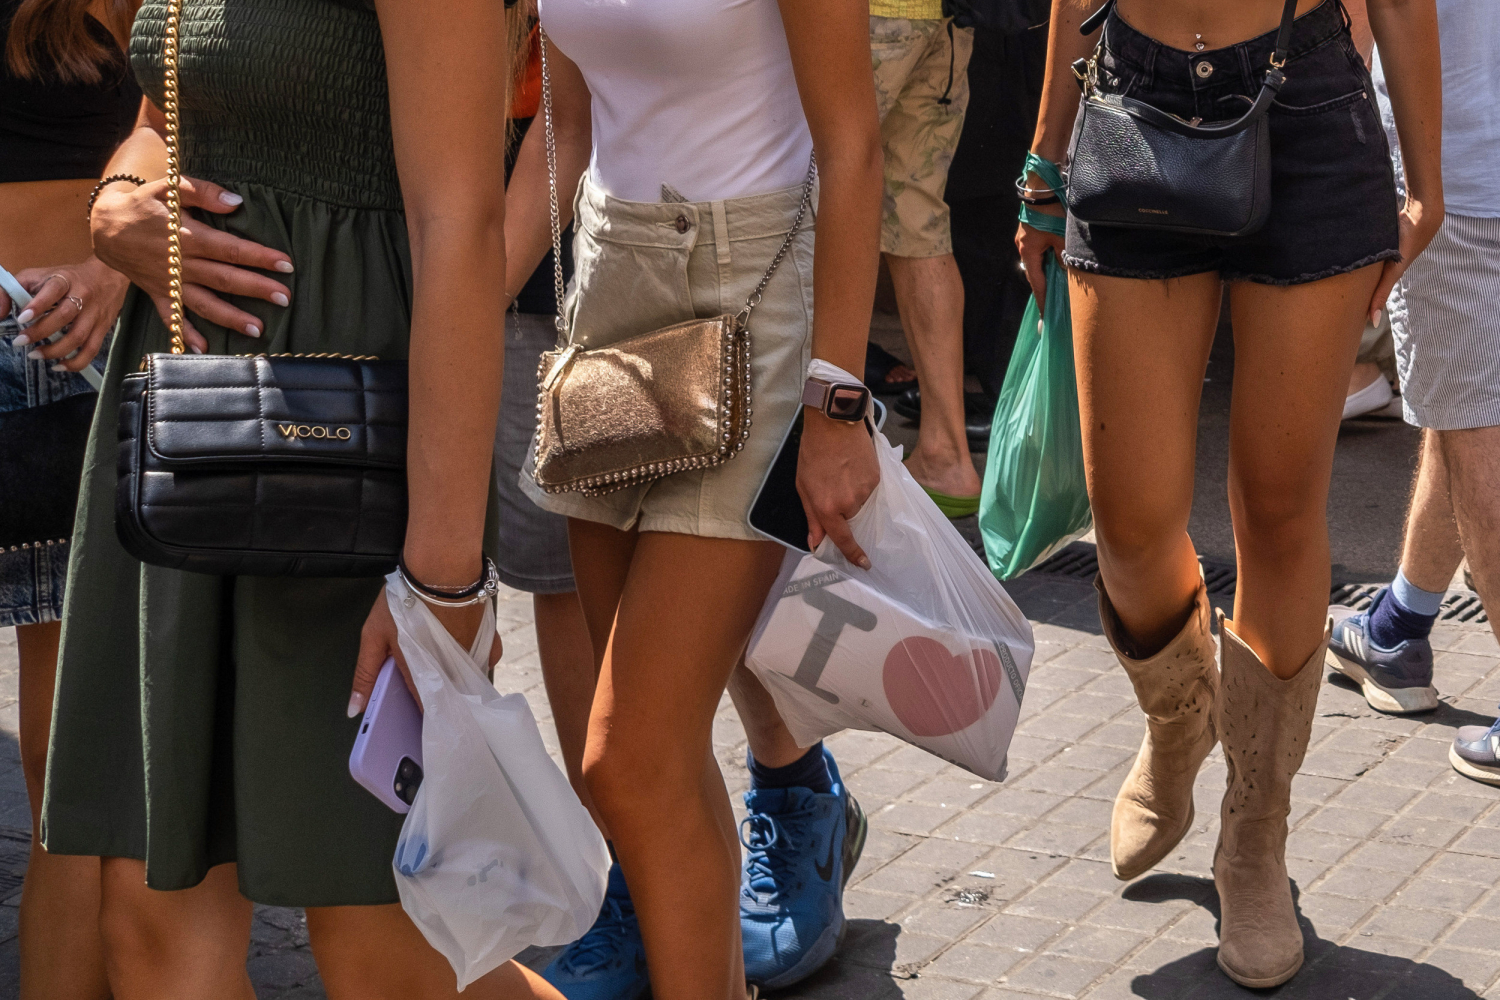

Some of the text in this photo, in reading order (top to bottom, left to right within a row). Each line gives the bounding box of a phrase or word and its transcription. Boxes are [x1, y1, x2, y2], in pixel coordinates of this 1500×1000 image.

[782, 573, 840, 595] ADE IN SPAIN
[999, 643, 1018, 680] PRODUCTO
